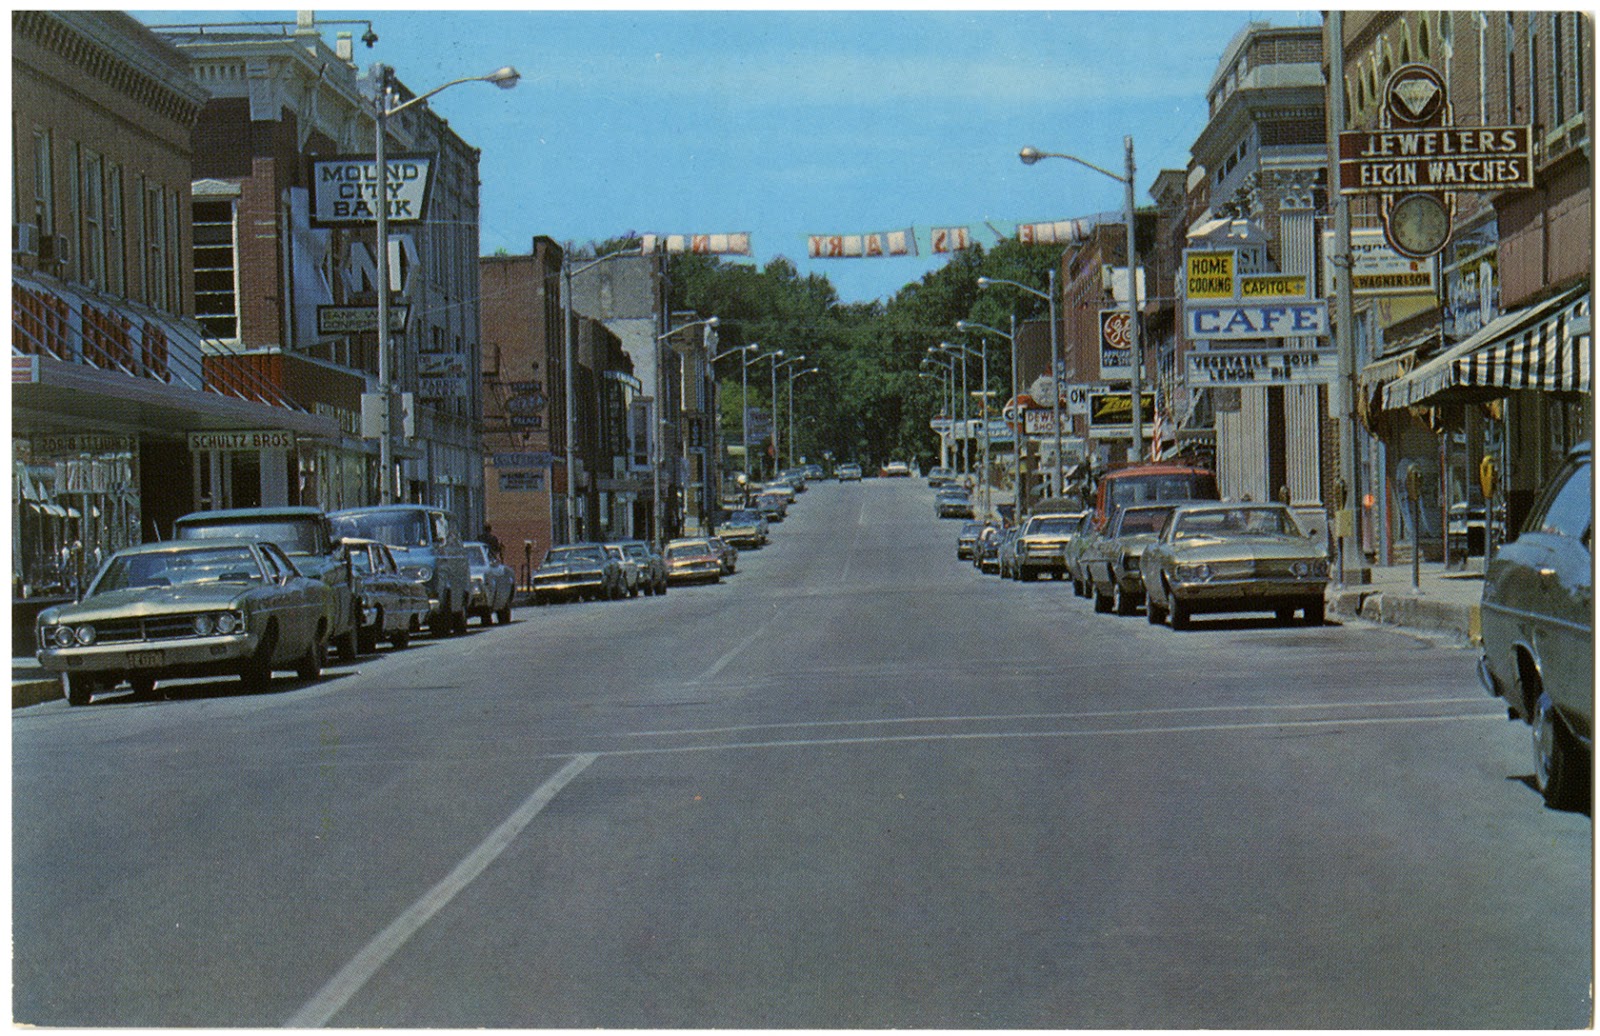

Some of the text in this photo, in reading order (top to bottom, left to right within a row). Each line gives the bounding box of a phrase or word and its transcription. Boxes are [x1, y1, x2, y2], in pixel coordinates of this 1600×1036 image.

[1361, 130, 1517, 156] JEWELERS
[1361, 160, 1520, 186] ELGIN WATCHES
[1192, 258, 1228, 275] HOME
[1189, 277, 1232, 293] COOKING
[1243, 280, 1292, 295] CAPITOL
[1194, 307, 1319, 334] CAFE
[1194, 353, 1319, 369] VEGETABLE SOUP
[1209, 366, 1292, 381] LEMON PIE
[192, 433, 246, 449] SCHULTZ
